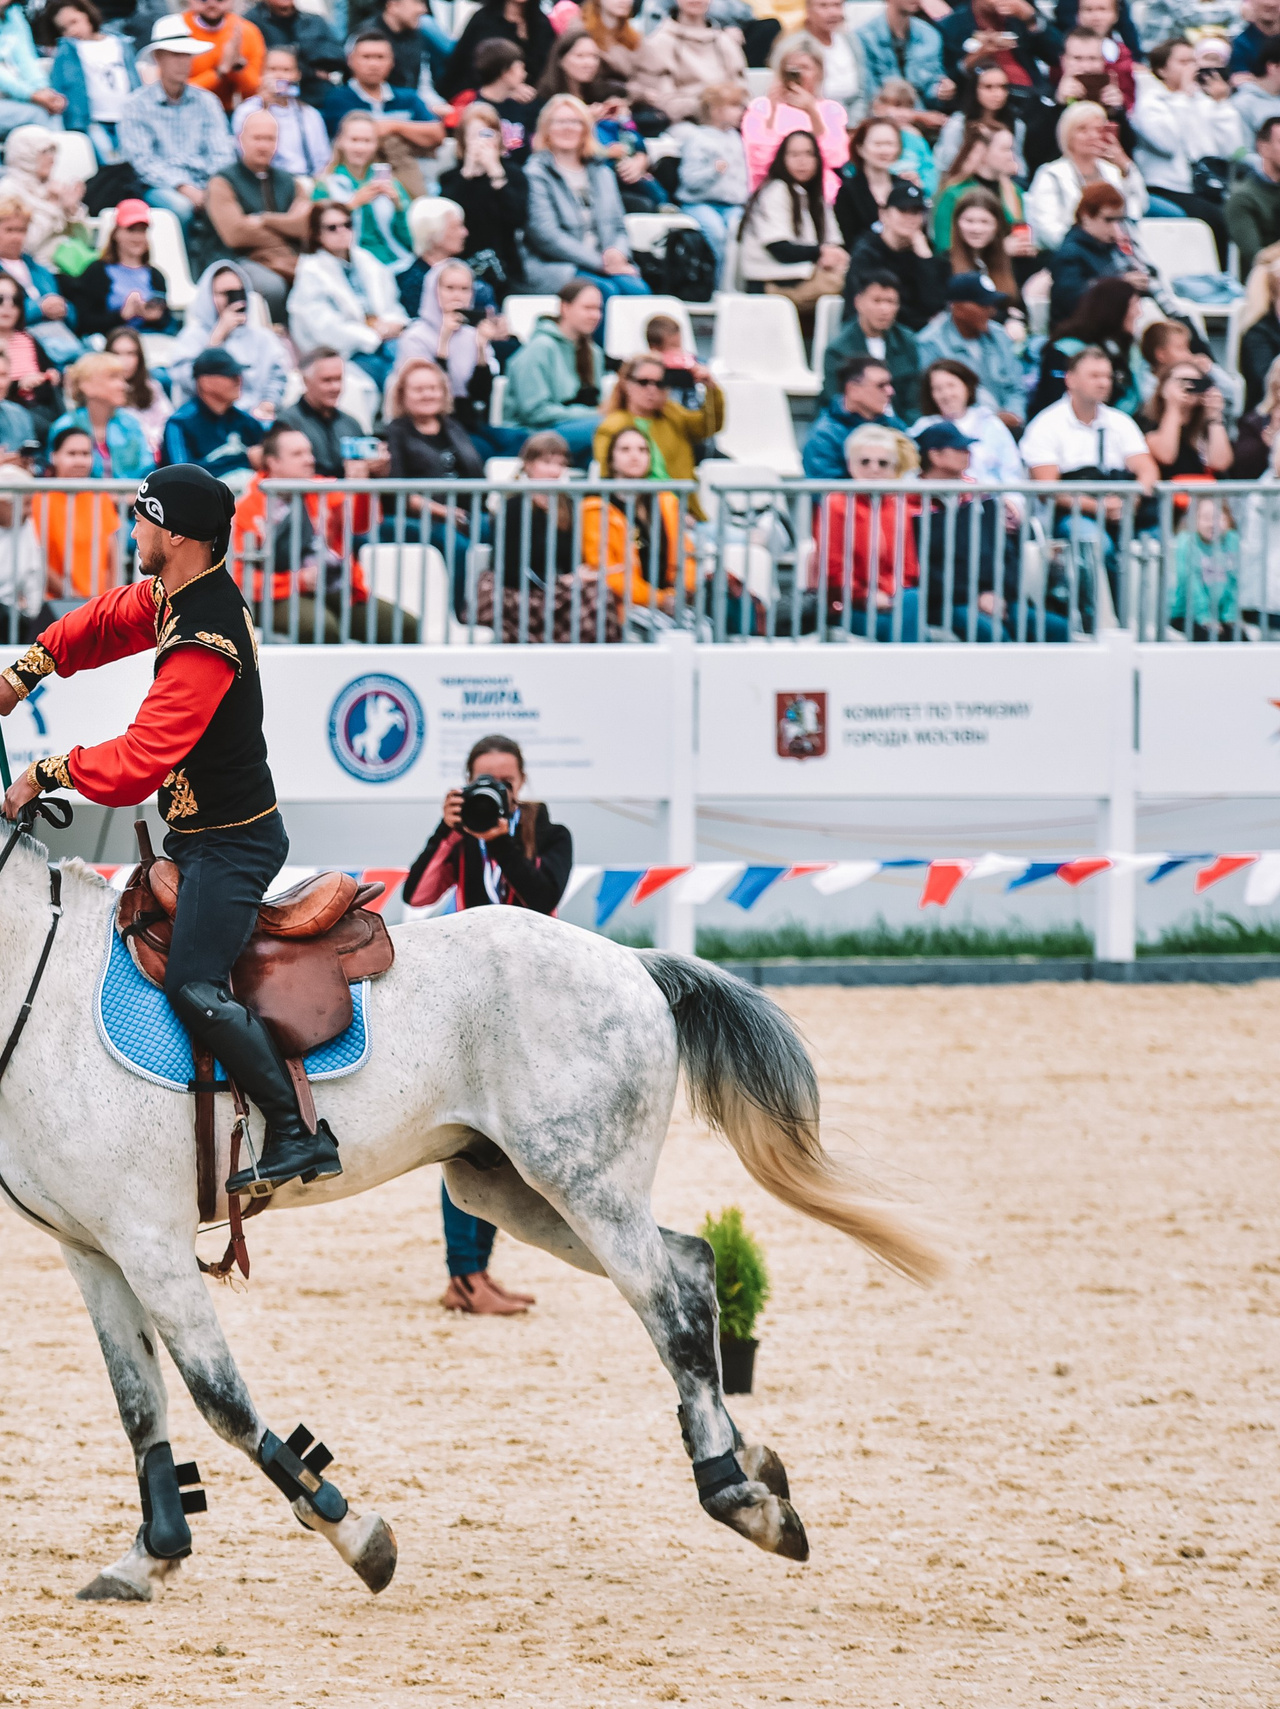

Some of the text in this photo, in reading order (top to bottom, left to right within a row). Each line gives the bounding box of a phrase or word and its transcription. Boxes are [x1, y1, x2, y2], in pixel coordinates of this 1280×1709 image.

[843, 704, 922, 722] КОМИТЕТ
[926, 703, 951, 721] ПО
[843, 727, 989, 747] ГОРОДА МОСКВЫ
